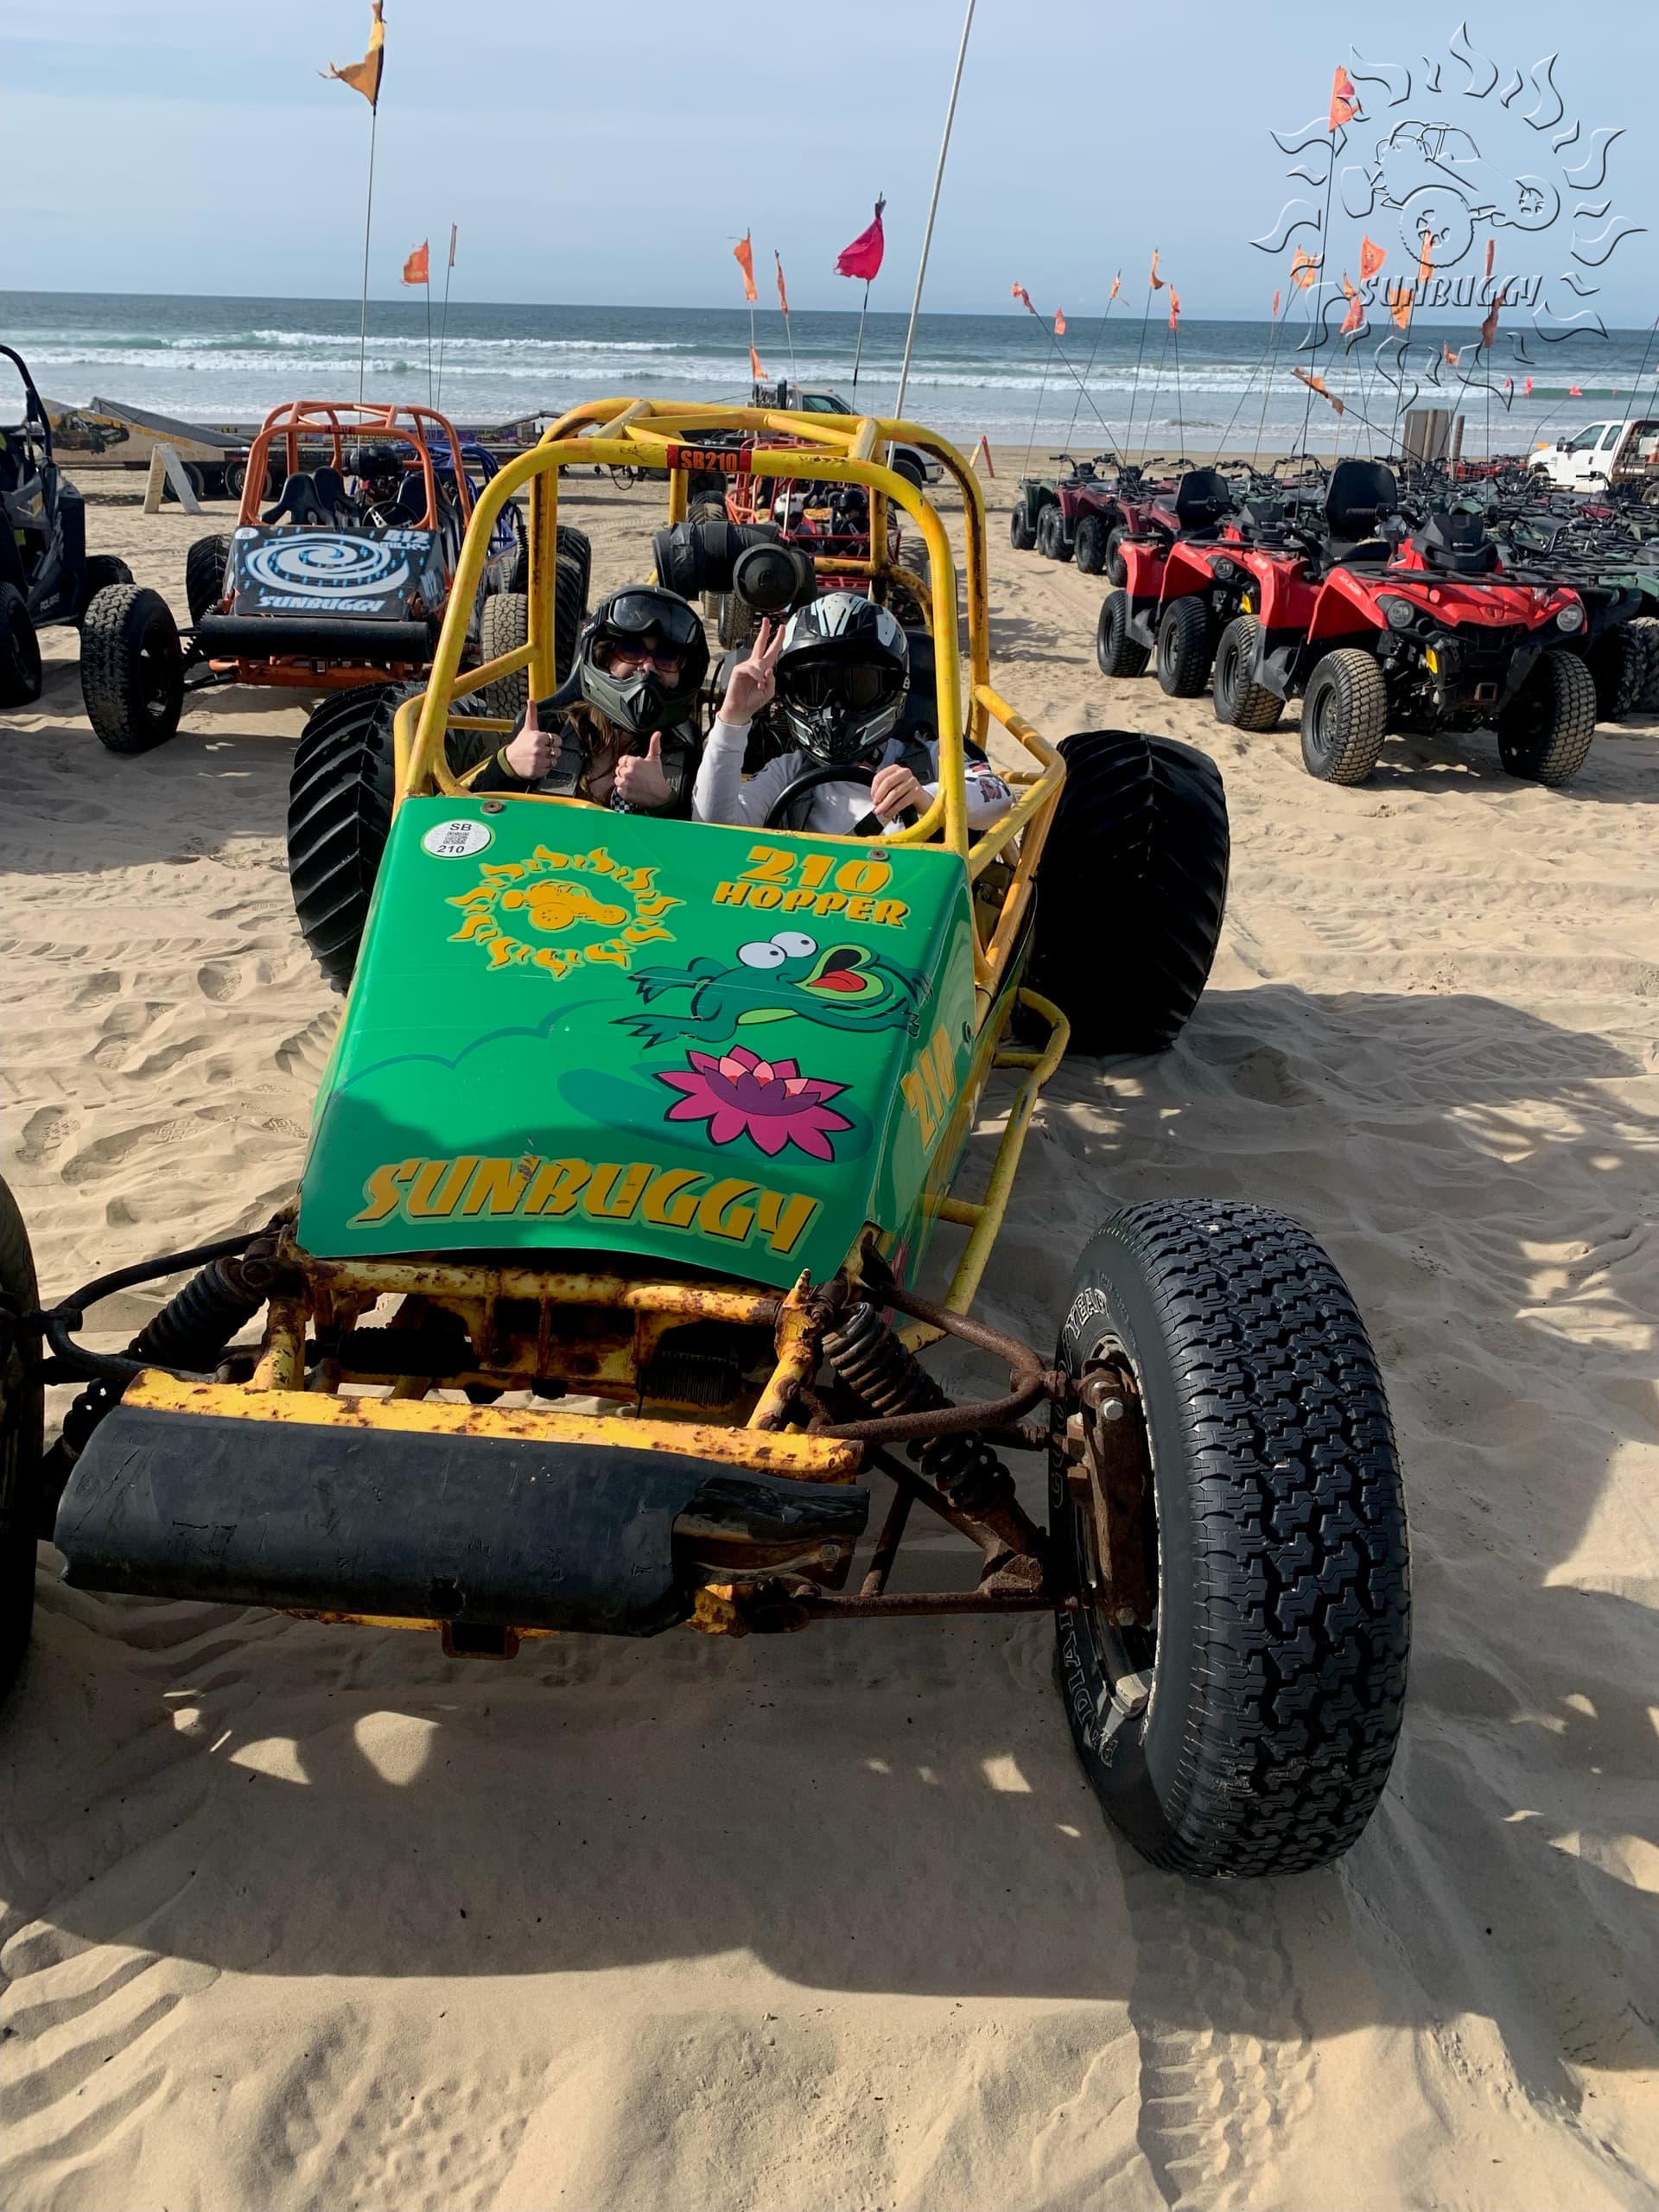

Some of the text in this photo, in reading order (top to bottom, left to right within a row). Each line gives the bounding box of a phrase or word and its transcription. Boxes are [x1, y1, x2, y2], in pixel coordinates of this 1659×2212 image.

[680, 449, 738, 472] SB210
[255, 595, 387, 613] SUNBUGGY
[449, 823, 473, 831] SB
[437, 844, 465, 854] 210
[739, 844, 892, 895] 210
[714, 881, 910, 928] HOPPER
[900, 1022, 957, 1152] 210
[353, 1155, 819, 1255] SUNBUGGY
